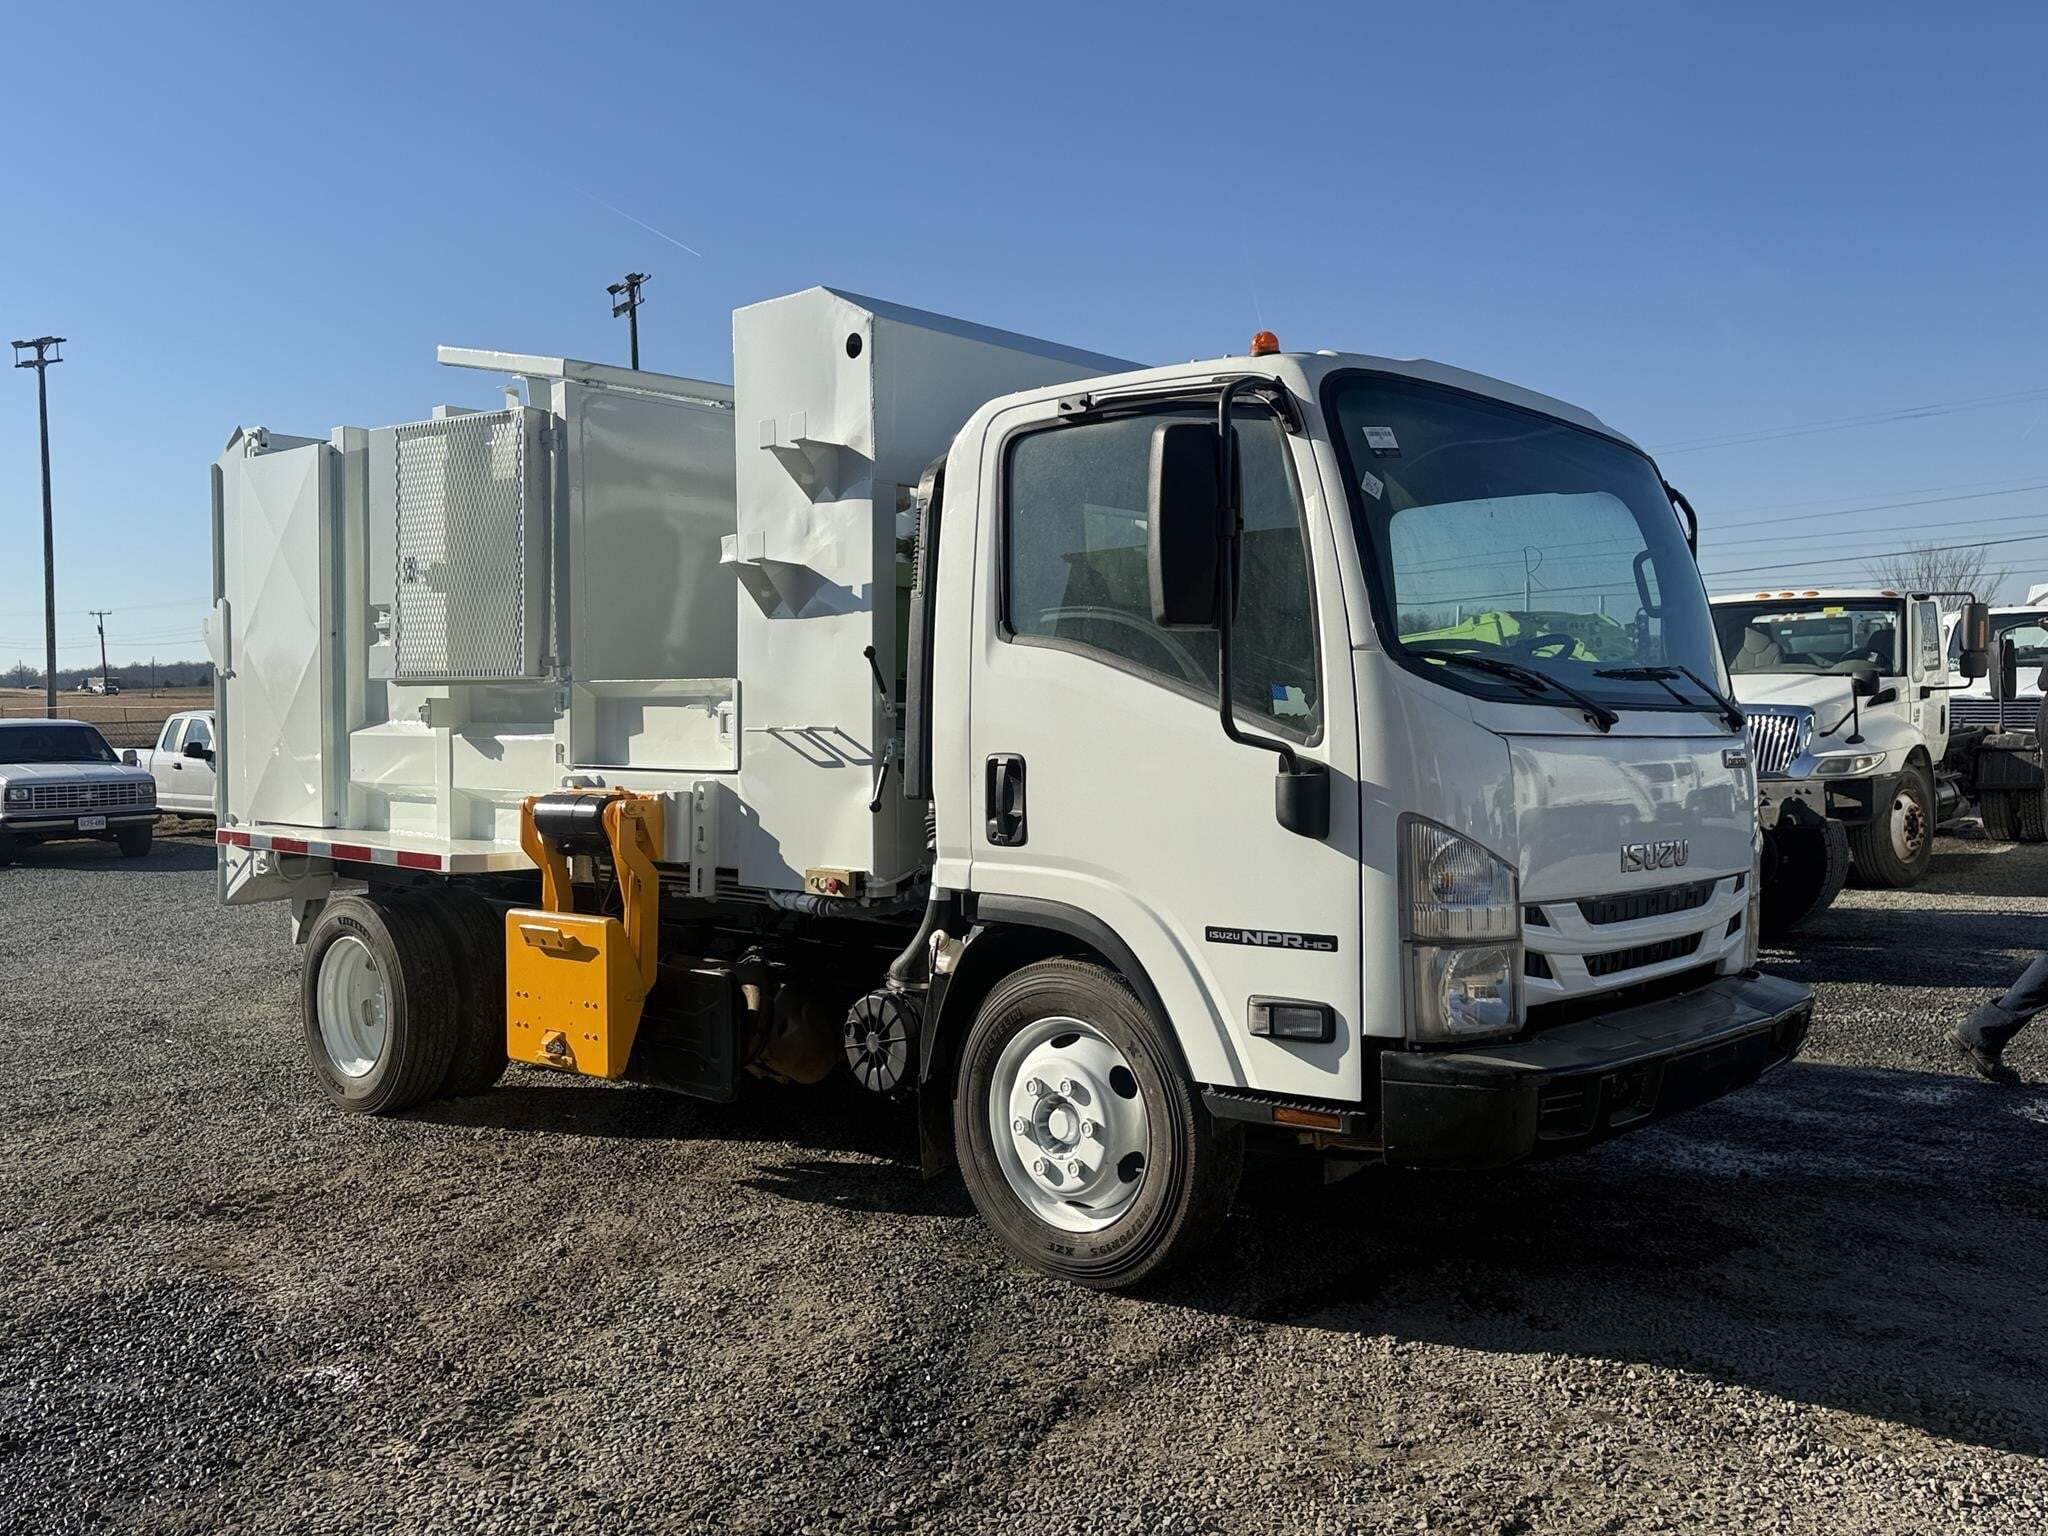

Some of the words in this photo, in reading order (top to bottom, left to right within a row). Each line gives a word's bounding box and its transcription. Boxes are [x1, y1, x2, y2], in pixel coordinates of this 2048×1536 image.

[1620, 839, 1689, 873] ISUZU
[1209, 931, 1240, 940] ISUZU
[1241, 931, 1303, 947] NPR
[1304, 941, 1332, 950] HD
